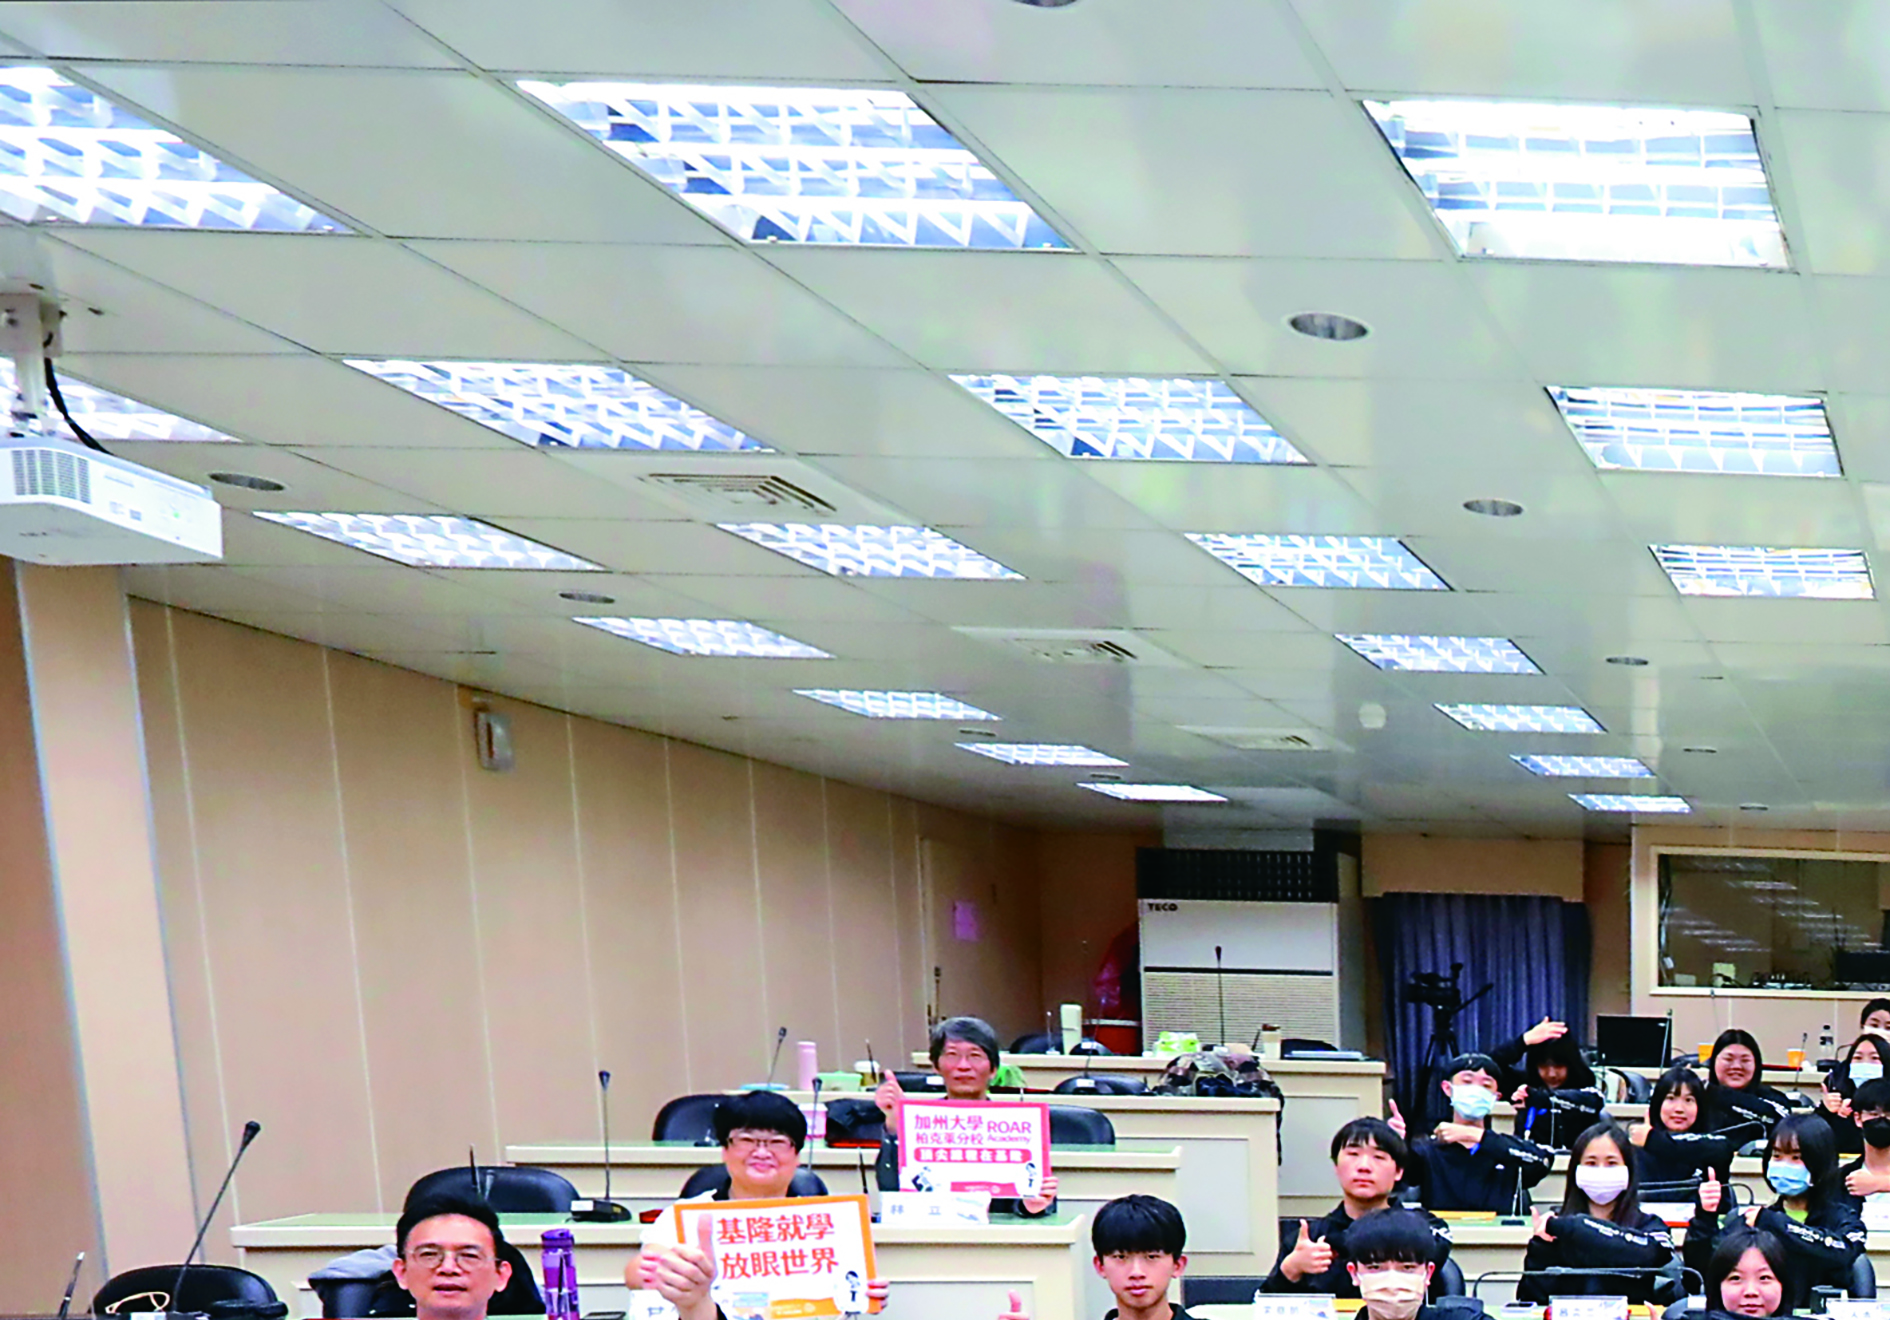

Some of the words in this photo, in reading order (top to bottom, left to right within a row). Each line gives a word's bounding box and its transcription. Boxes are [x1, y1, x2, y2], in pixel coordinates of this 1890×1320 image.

[1147, 902, 1179, 912] TECO
[914, 1114, 984, 1131] 加州大學
[986, 1120, 1032, 1134] ROAR
[915, 1132, 984, 1145] 柏克萊分校
[986, 1134, 1032, 1144] Academy
[716, 1212, 835, 1246] 基隆就學
[720, 1246, 840, 1281] 放眼世界
